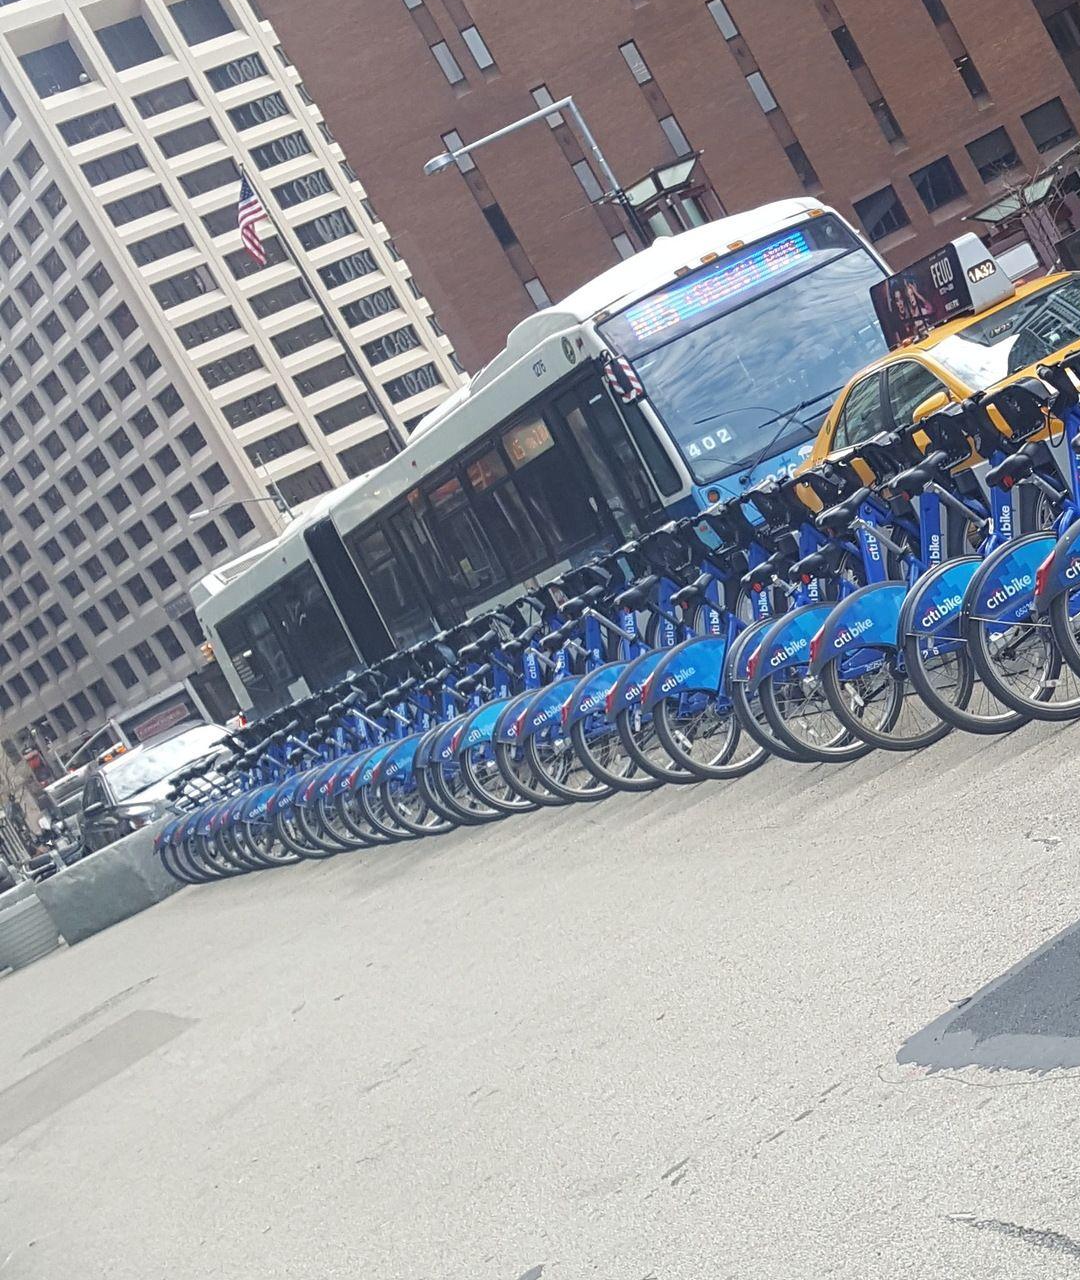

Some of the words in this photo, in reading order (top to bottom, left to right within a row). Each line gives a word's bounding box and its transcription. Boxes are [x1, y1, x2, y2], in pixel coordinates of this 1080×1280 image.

[930, 256, 954, 289] FEUD
[969, 260, 995, 283] 1A32
[688, 428, 733, 457] 402
